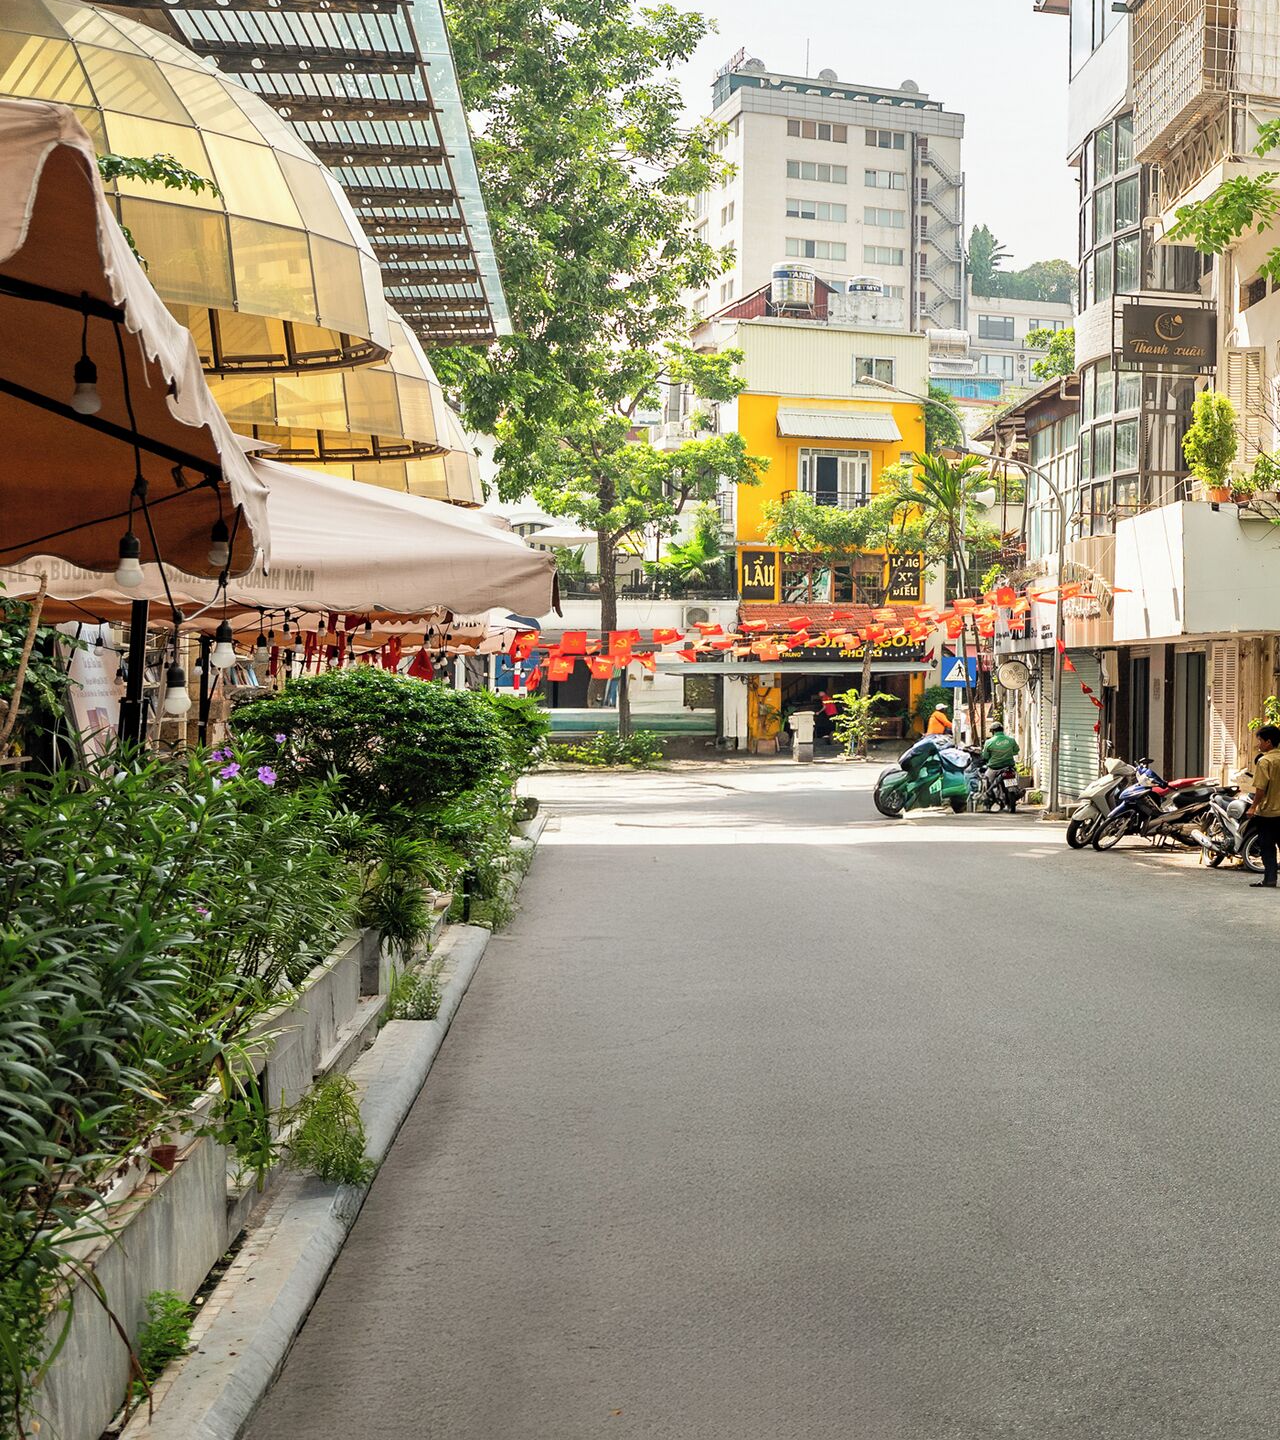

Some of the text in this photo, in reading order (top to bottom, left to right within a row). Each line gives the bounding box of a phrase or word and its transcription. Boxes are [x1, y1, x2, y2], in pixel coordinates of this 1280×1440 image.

[1130, 339, 1206, 356] Thanh xuân
[284, 564, 316, 592] NĂM
